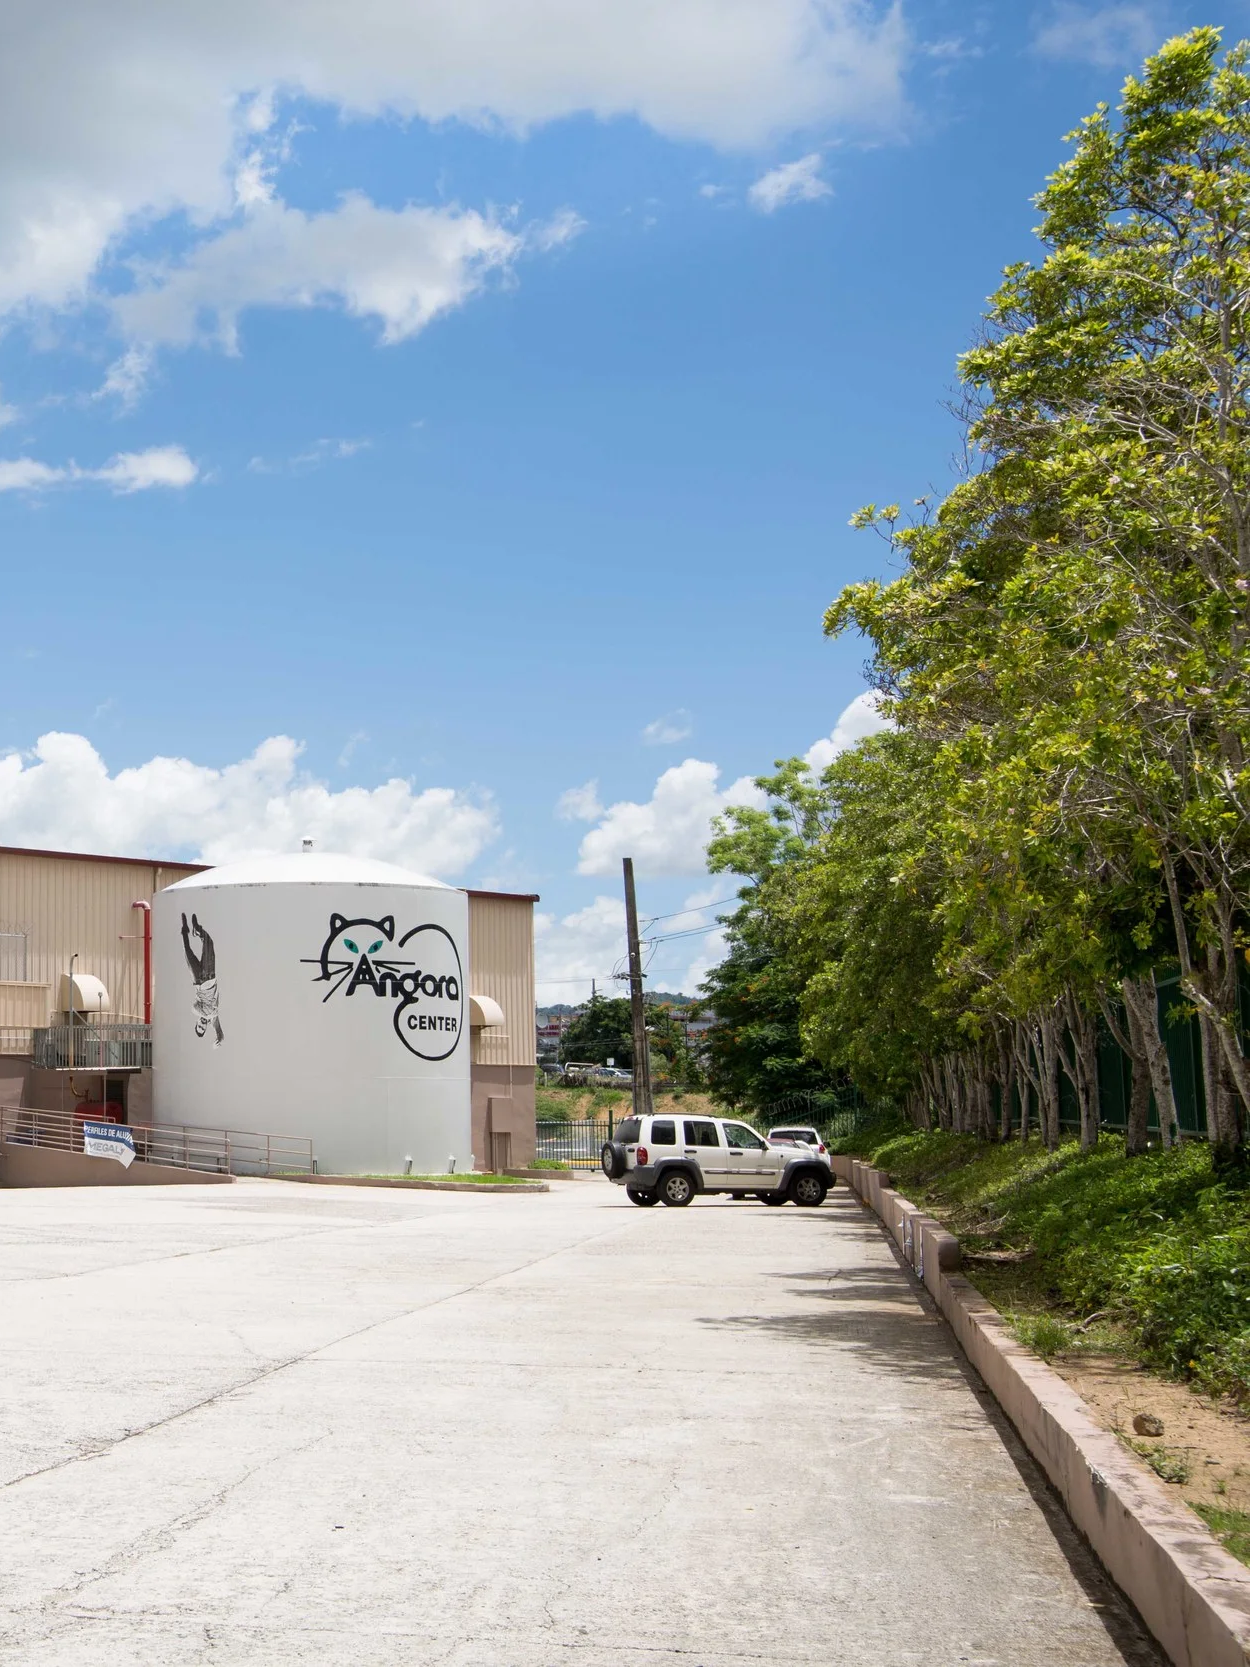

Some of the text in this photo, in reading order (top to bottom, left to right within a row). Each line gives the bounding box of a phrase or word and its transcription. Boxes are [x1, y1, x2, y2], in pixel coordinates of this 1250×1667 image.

[345, 953, 459, 1004] Angora
[407, 1014, 457, 1032] CENTER
[84, 1125, 108, 1137] PERFILES
[108, 1128, 116, 1138] DE
